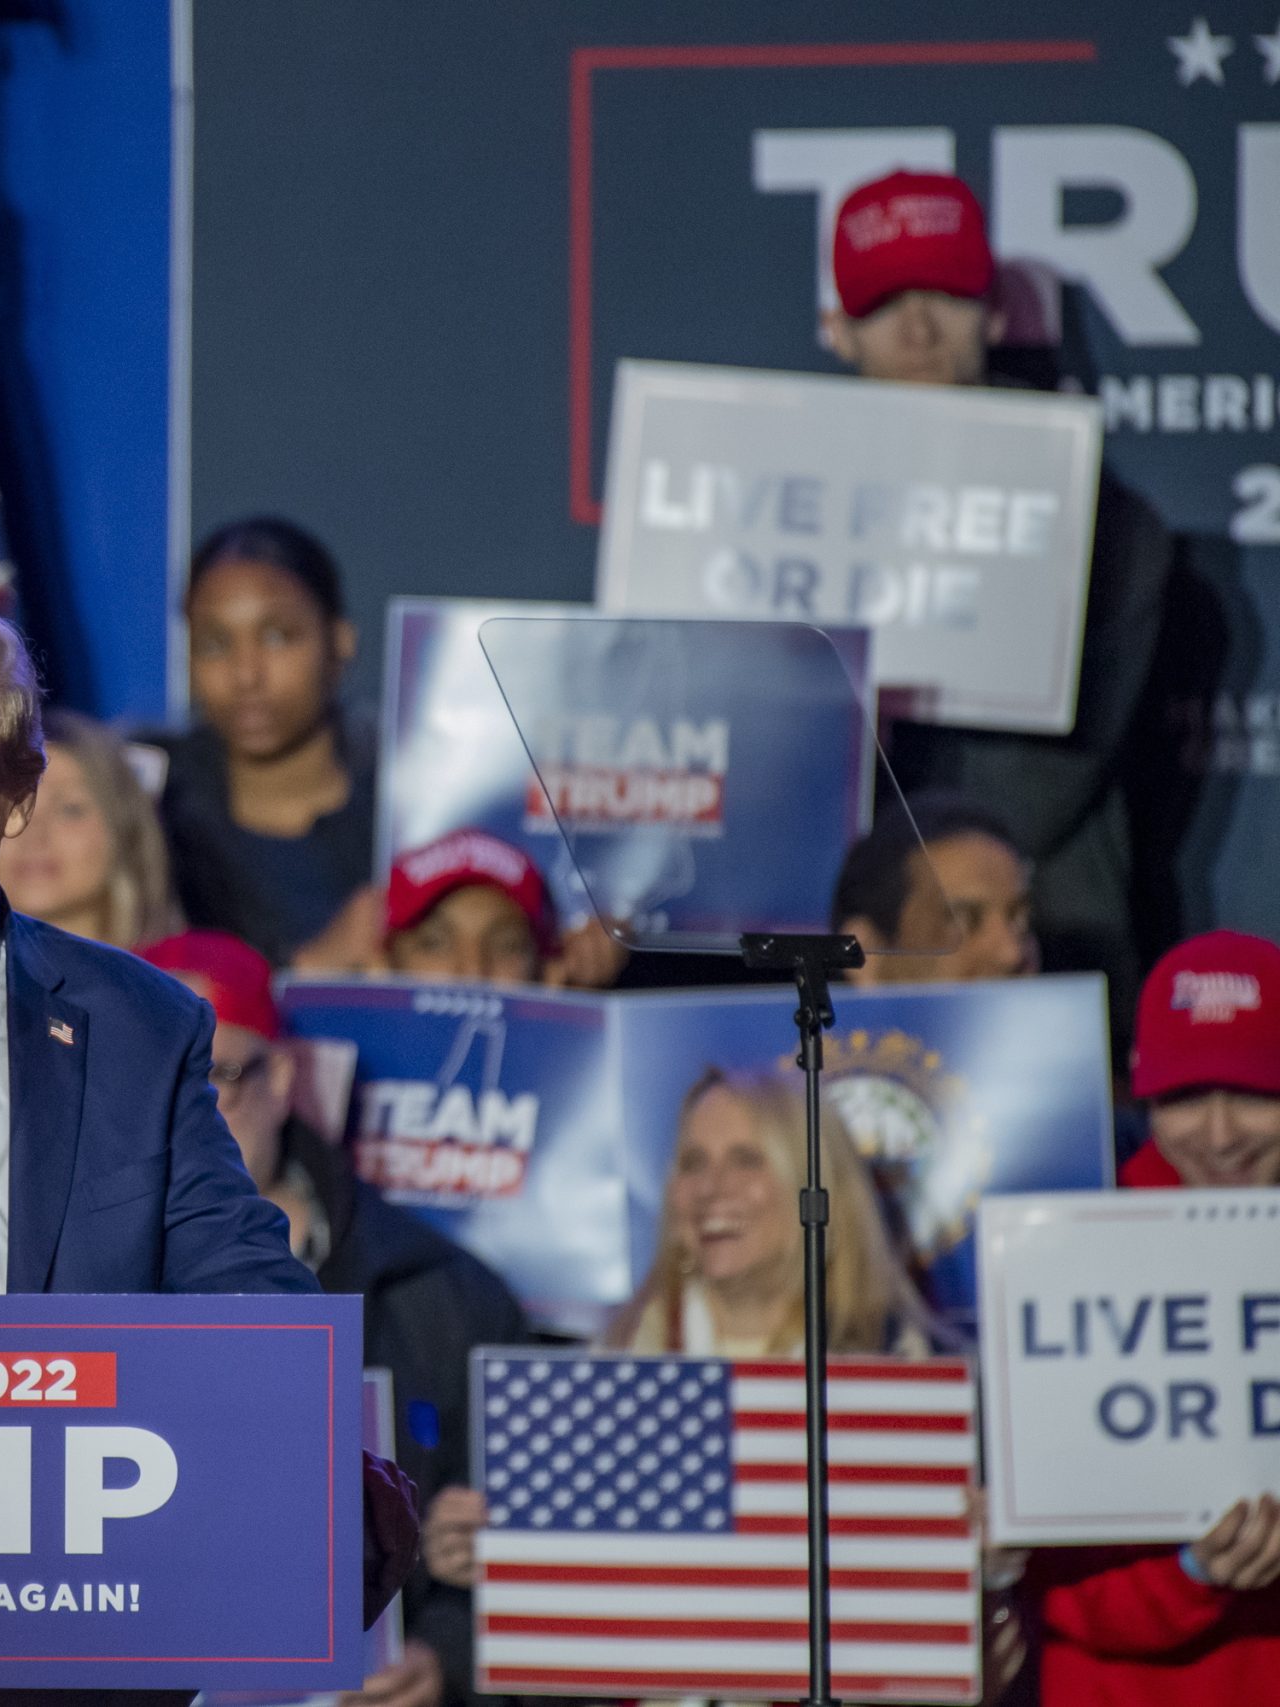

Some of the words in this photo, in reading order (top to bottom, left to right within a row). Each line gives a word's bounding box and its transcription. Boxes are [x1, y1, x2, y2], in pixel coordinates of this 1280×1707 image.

[1096, 373, 1280, 433] MERI
[642, 459, 826, 535] LIVE
[848, 478, 1059, 557] FREE
[703, 545, 822, 614] OR
[847, 556, 980, 630] DIE
[359, 1078, 540, 1151] TEAM
[1022, 1293, 1212, 1358] LIVE
[1096, 1379, 1219, 1442] OR
